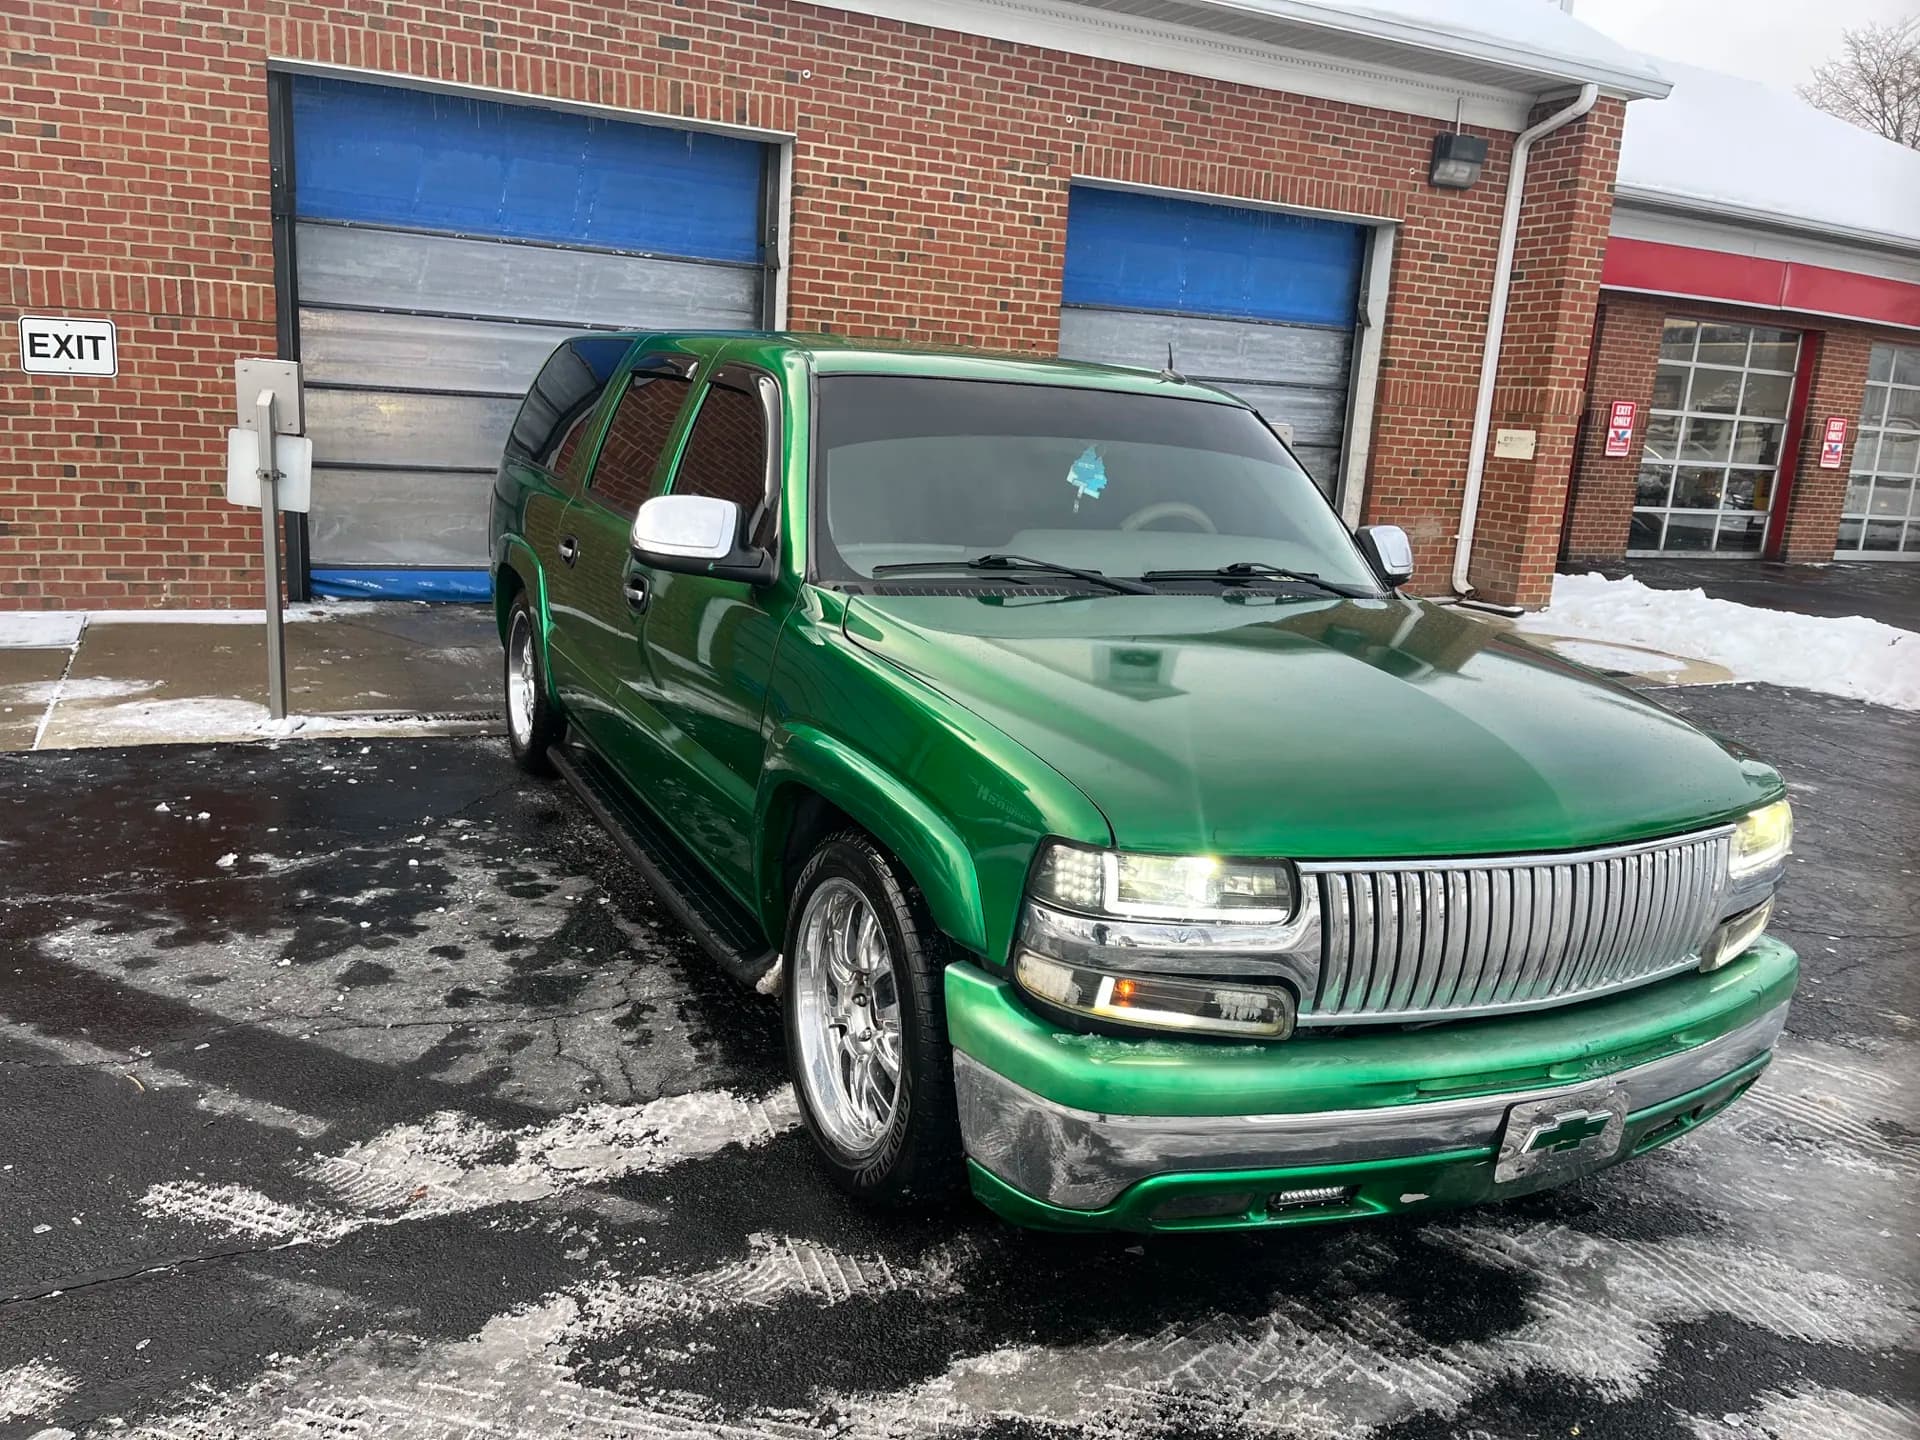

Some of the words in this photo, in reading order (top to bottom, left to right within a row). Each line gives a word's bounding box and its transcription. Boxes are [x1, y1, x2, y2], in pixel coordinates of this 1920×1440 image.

[28, 332, 106, 361] EXIT
[1615, 405, 1632, 415] EXIT
[1613, 416, 1632, 426] ONLY
[1830, 421, 1844, 430] EXIT
[1828, 431, 1842, 441] ONLY
